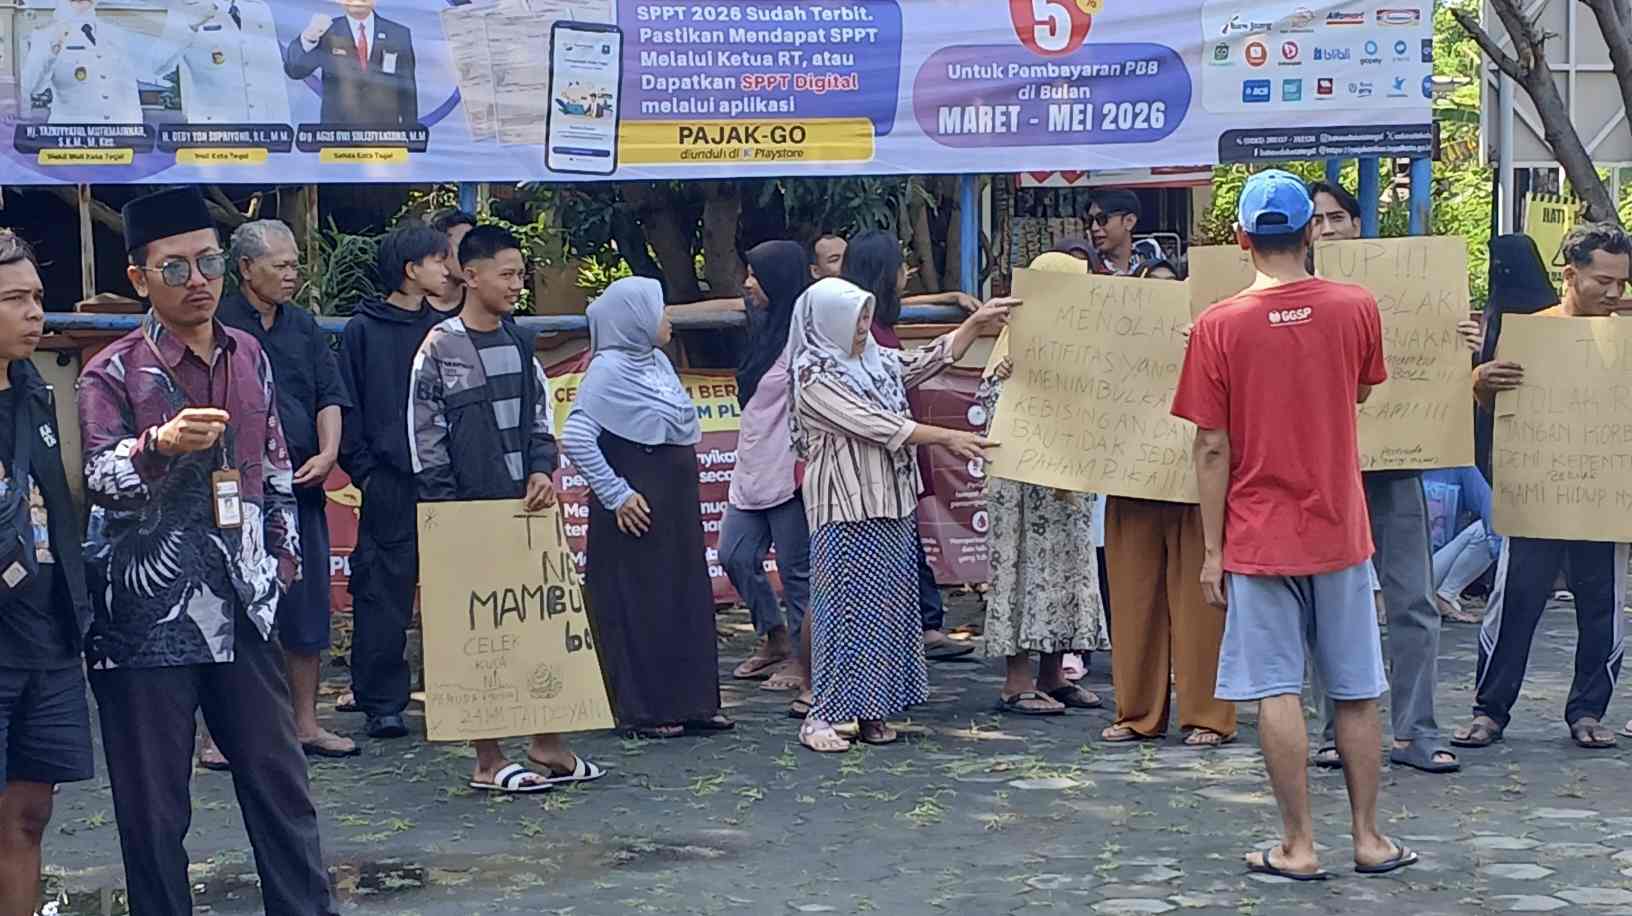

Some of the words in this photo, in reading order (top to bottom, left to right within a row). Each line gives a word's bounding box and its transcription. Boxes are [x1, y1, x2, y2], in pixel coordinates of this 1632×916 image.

[637, 6, 686, 21] SPPT
[691, 6, 741, 20] 2026
[746, 6, 807, 21] Sudah
[812, 6, 874, 21] Terbit.
[1032, 0, 1072, 50] 5
[640, 28, 725, 43] Pastikan
[729, 28, 826, 47] Mendapat
[830, 28, 878, 43] SPPT
[640, 51, 713, 67] Melalui
[717, 51, 773, 67] Ketua
[777, 51, 807, 69] RT,
[812, 52, 855, 66] atau
[948, 64, 1003, 80] Untuk
[1008, 62, 1121, 81] Pembayaran
[1124, 60, 1159, 75] PBB
[642, 74, 736, 93] Dapatkan
[740, 74, 791, 91] SPPT
[794, 73, 860, 93] Digital
[1018, 85, 1035, 100] di
[1040, 84, 1090, 99] Bulan
[641, 97, 715, 113] melalui
[719, 97, 796, 116] aplikasi
[938, 105, 1020, 135] MARET
[1048, 103, 1093, 132] MEI
[1102, 102, 1166, 131] 2026
[678, 126, 807, 145] PAJAK-GO
[729, 148, 740, 159] di
[754, 148, 804, 160] Playstore
[1055, 305, 1184, 343] MENOLAK
[1024, 336, 1113, 374] AKTIFITAS
[1024, 367, 1176, 409] MENIMBULKA
[1014, 393, 1147, 434] KEBISINGAN
